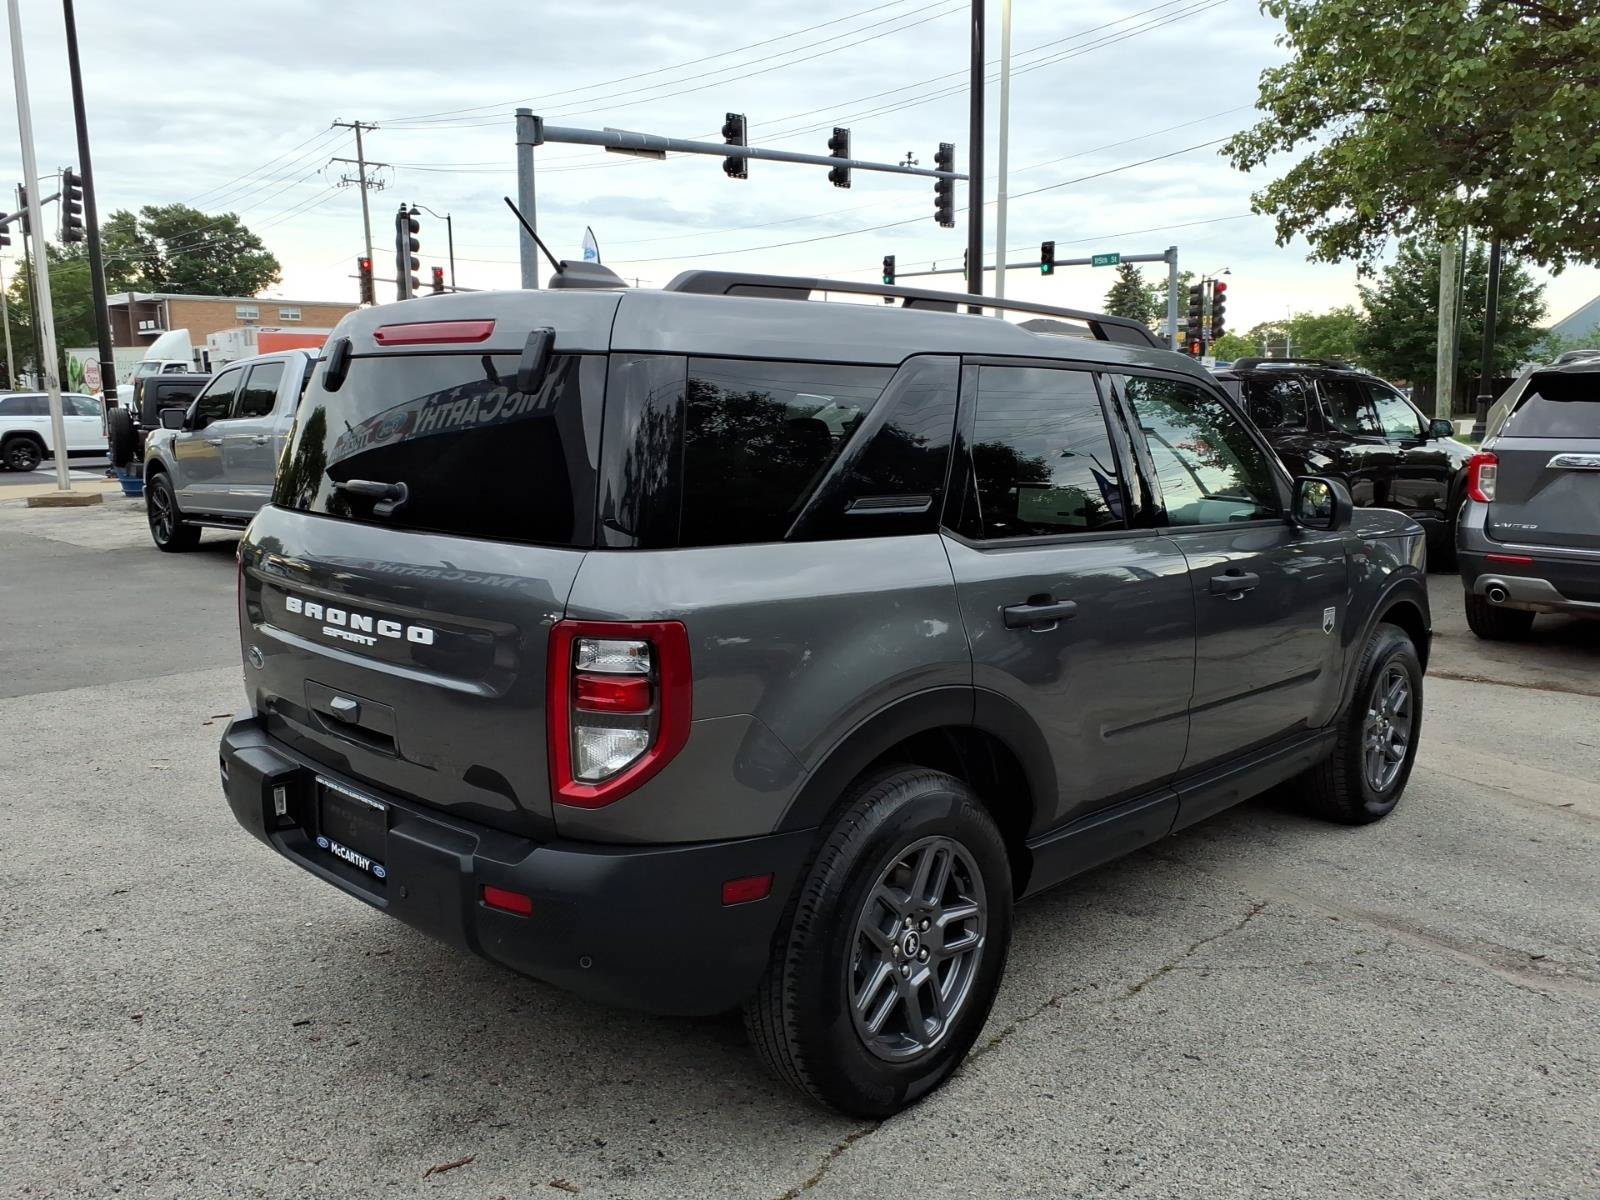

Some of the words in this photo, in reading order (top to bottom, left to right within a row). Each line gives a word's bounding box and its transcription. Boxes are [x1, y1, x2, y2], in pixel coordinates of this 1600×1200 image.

[286, 596, 434, 646] BRONCO
[322, 626, 378, 646] SPORT
[331, 842, 370, 871] McCARTHY
